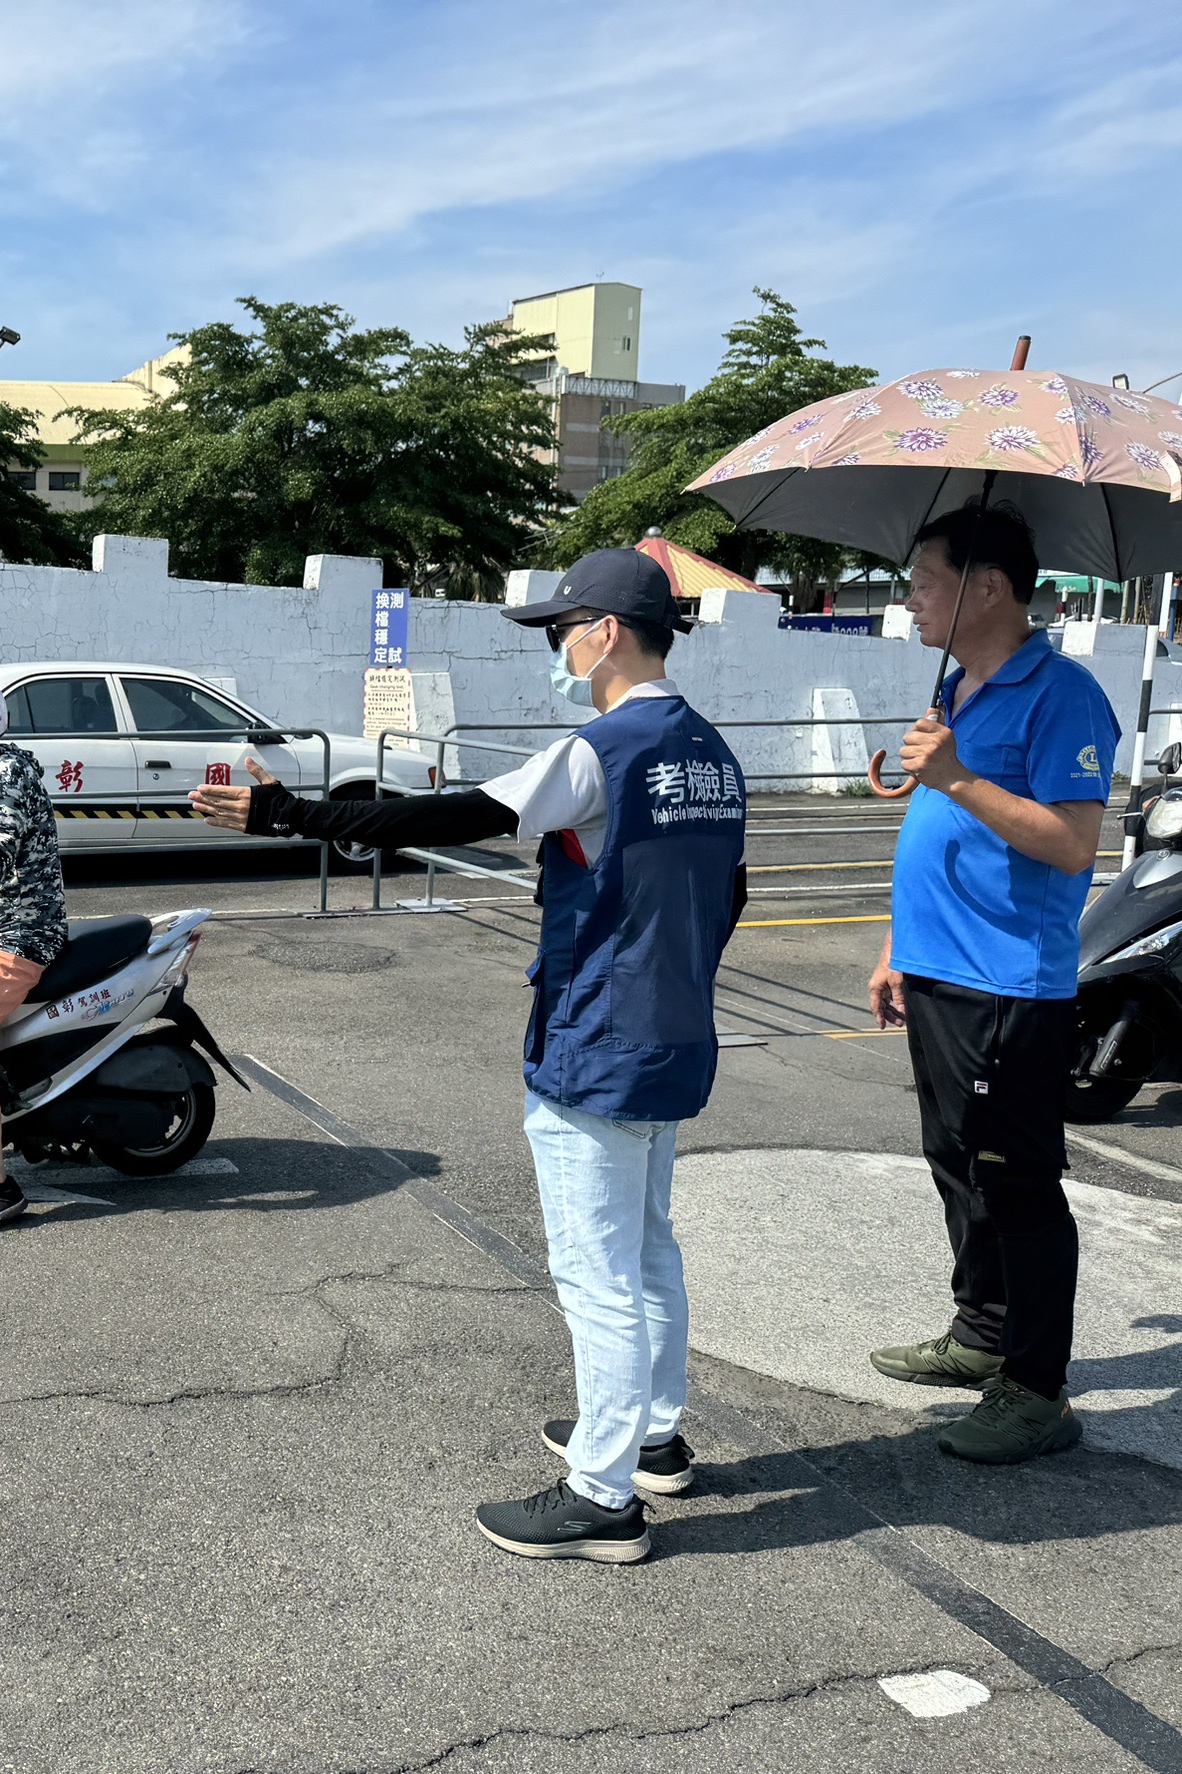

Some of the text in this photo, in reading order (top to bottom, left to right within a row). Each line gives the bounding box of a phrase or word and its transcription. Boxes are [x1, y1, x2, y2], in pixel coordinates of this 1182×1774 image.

[55, 760, 231, 793] 彰 國
[651, 804, 687, 825] Vehicle
